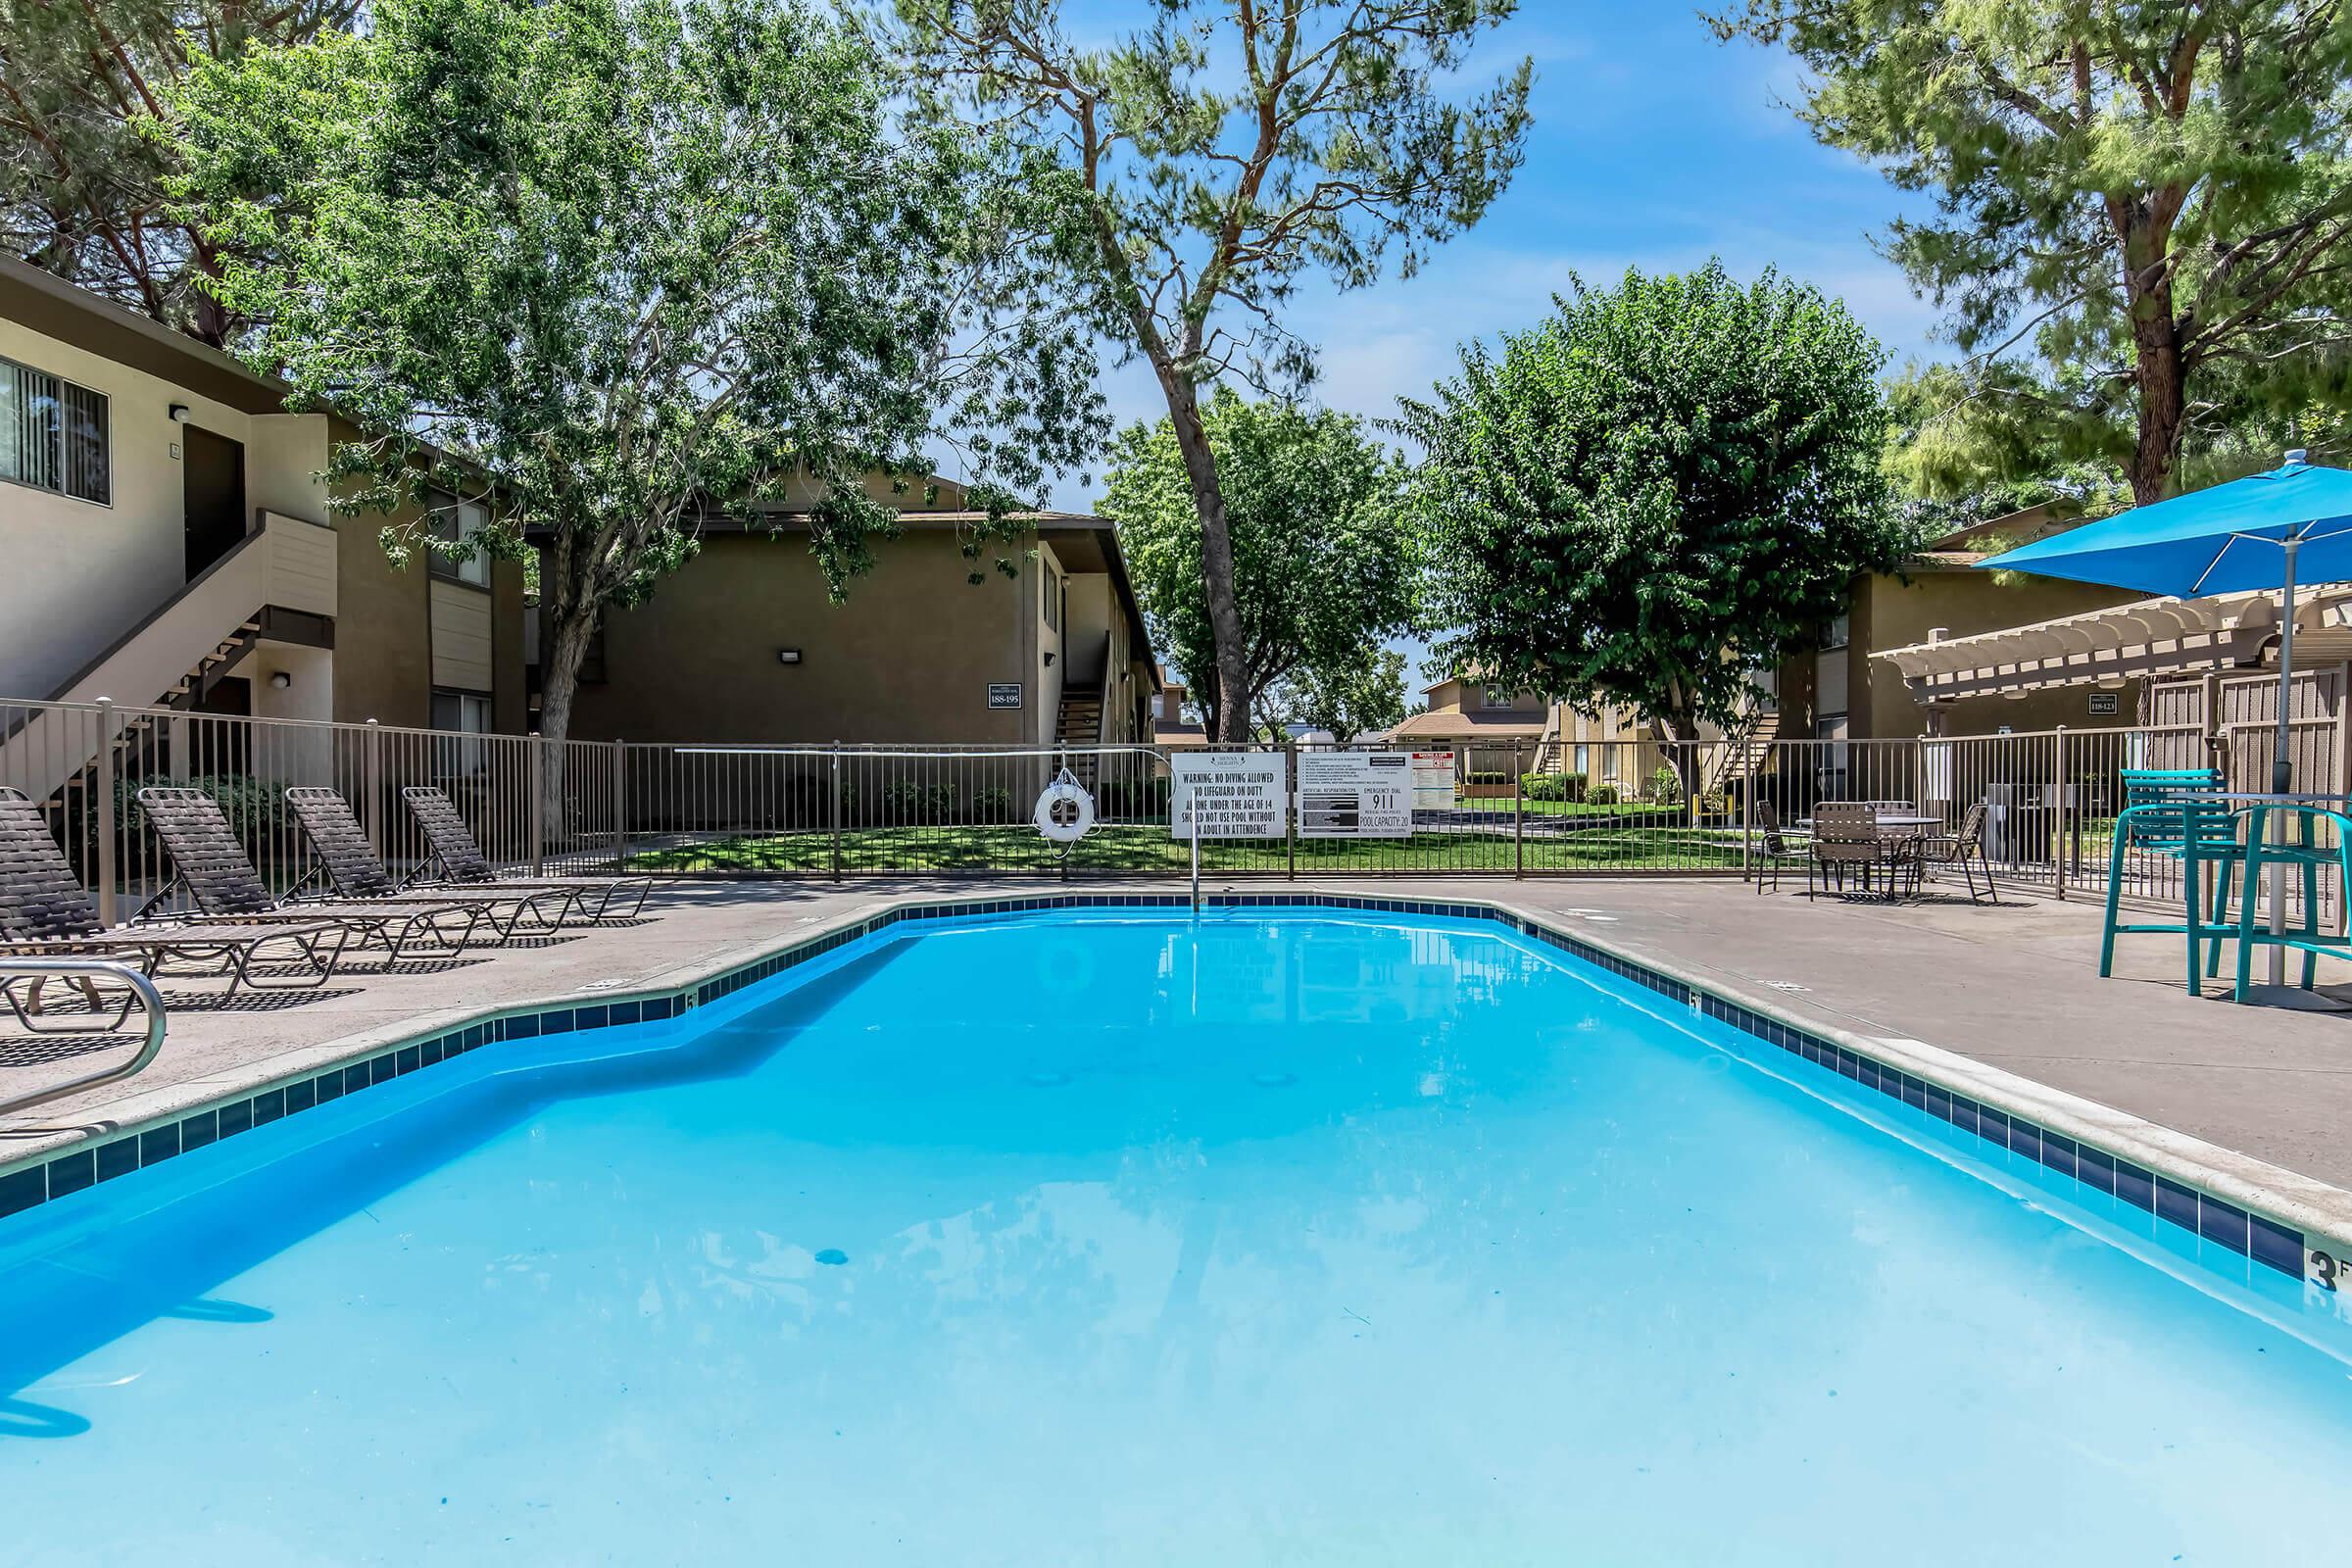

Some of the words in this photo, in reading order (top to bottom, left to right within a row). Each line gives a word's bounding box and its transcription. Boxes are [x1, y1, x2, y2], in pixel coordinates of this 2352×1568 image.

[992, 695, 1019, 704] 188-195
[1183, 773, 1214, 783] WARNING:
[1215, 773, 1224, 783] NO
[1226, 773, 1246, 783] DIVING
[1248, 773, 1274, 783] ALLOWED
[1204, 786, 1235, 797] LIFEGUARD
[1237, 786, 1246, 797] ON
[1248, 786, 1263, 797] DUTY
[1186, 800, 1207, 810] AONE
[1210, 800, 1230, 810] UNDER
[1231, 800, 1242, 810] THE
[1244, 800, 1254, 810] AGE
[1256, 800, 1264, 810] OF
[1265, 800, 1272, 809] 14
[1373, 794, 1394, 809] 911
[1182, 812, 1204, 822] SHOLD
[1205, 812, 1217, 822] NOT
[1219, 812, 1230, 822] USE
[1232, 812, 1247, 822] POOL
[1249, 812, 1276, 822] WITHOUT
[1360, 816, 1374, 827] POOL
[1203, 825, 1221, 835] ADULT
[1224, 825, 1230, 835] IN
[1232, 824, 1267, 835] ATTENDENCE
[2310, 1250, 2337, 1293] 3
